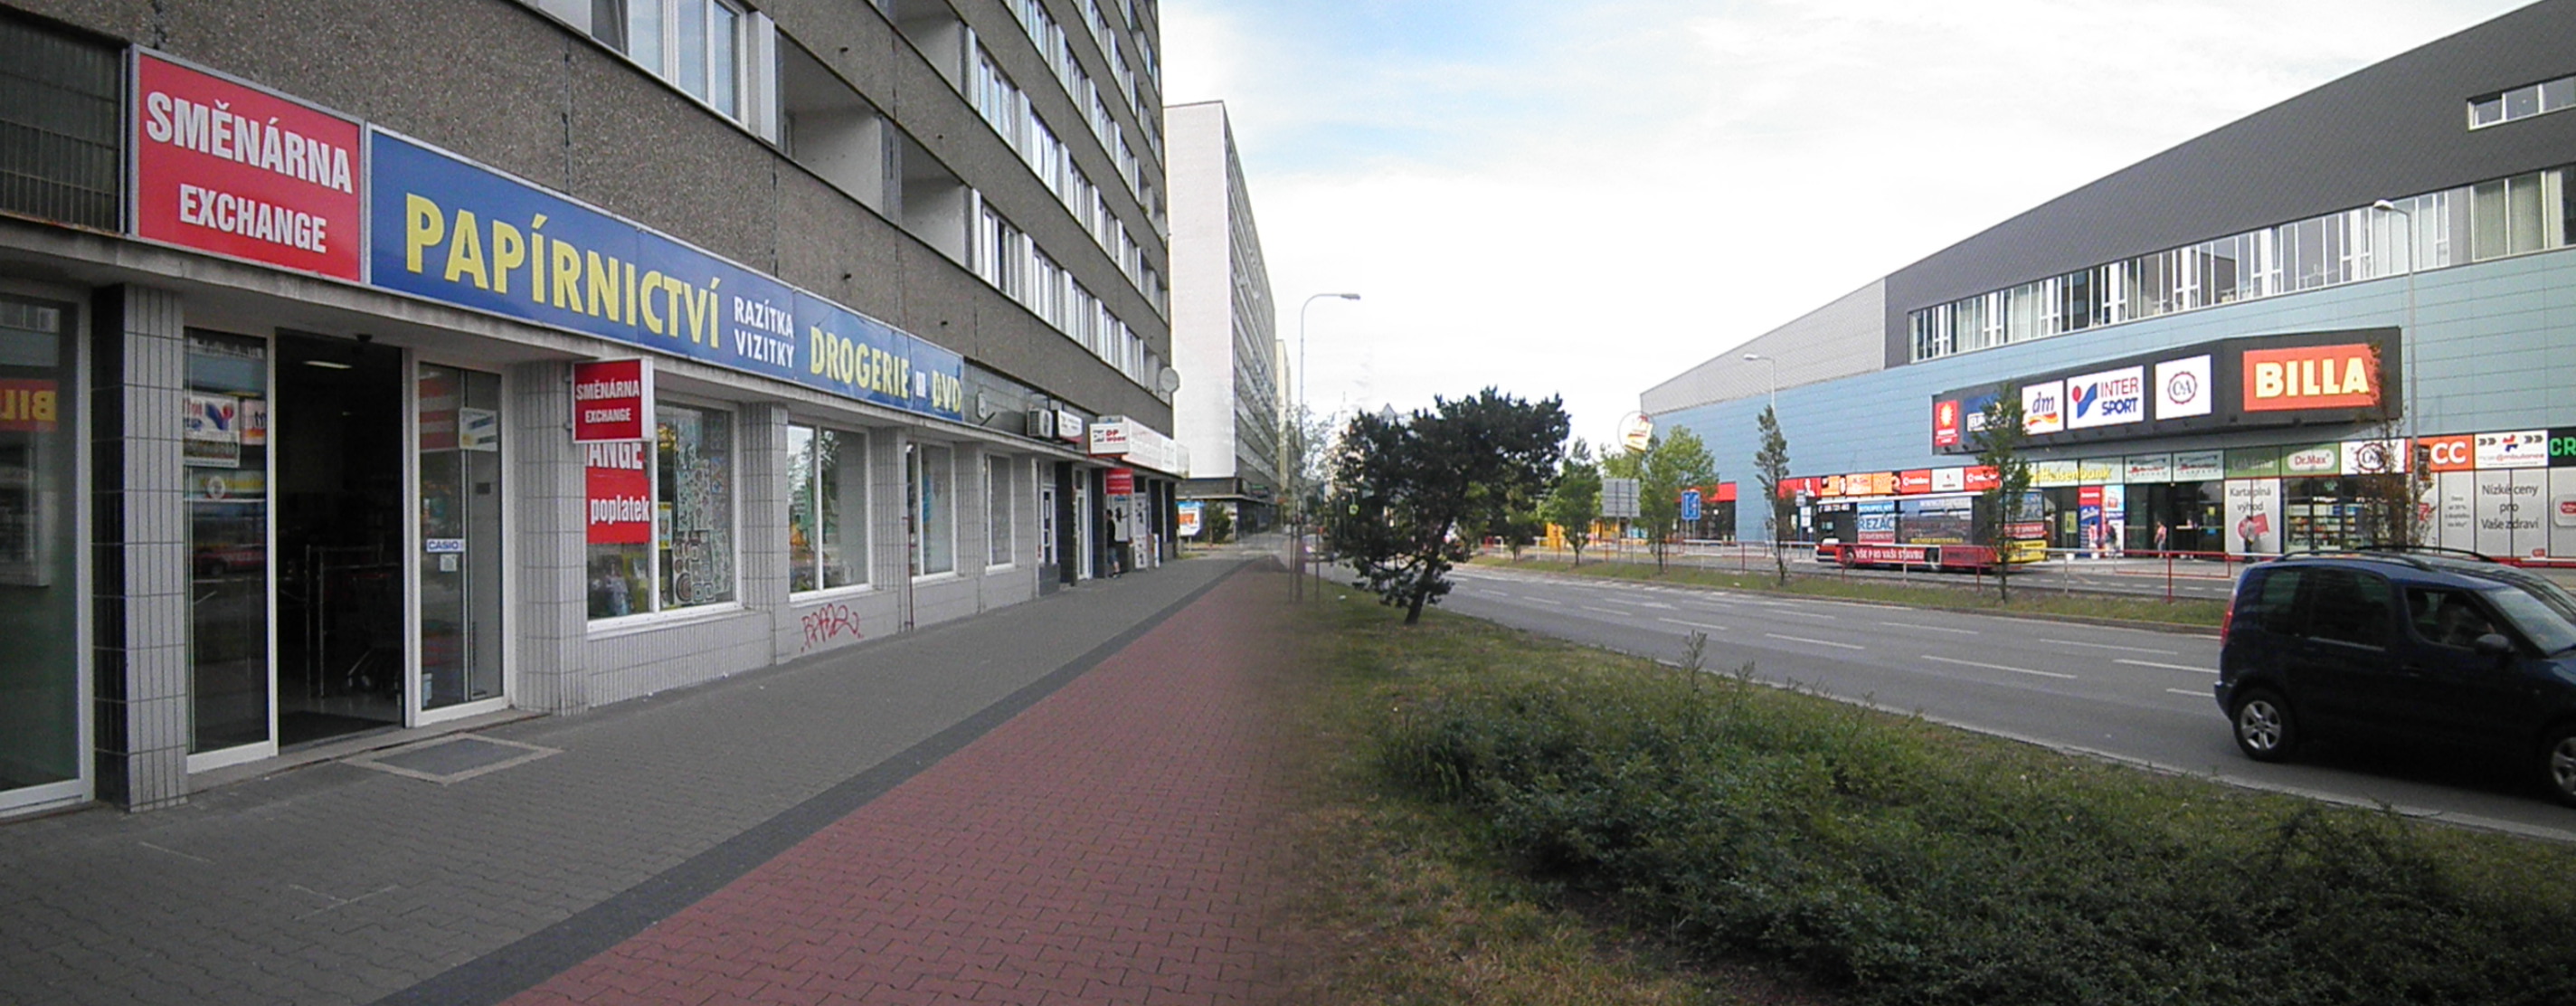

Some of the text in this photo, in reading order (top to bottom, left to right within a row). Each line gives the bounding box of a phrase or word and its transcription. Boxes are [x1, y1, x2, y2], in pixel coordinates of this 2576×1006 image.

[147, 91, 353, 195] SMĚNÁRNA
[180, 184, 327, 253] EXCHANGE
[407, 193, 721, 348] PAPÍRNICTVÍ
[734, 296, 794, 338] RAZÍTKA
[734, 329, 794, 368] VIZITKY
[810, 327, 961, 413] DROGERIE DVD
[2255, 357, 2370, 398] BILLA
[576, 378, 640, 400] SMĚNÁRNA
[2100, 376, 2139, 398] INTER
[2031, 391, 2055, 414] dm
[2101, 397, 2138, 416] SPORT
[585, 408, 631, 423] EXCHANGE
[2294, 454, 2326, 467] Dr.Max
[2230, 488, 2251, 497] Karta
[2514, 485, 2539, 497] ceny
[591, 495, 650, 525] poplatek
[2499, 503, 2519, 515] pro
[2481, 517, 2505, 529] Vaše
[429, 541, 459, 550] CASIO
